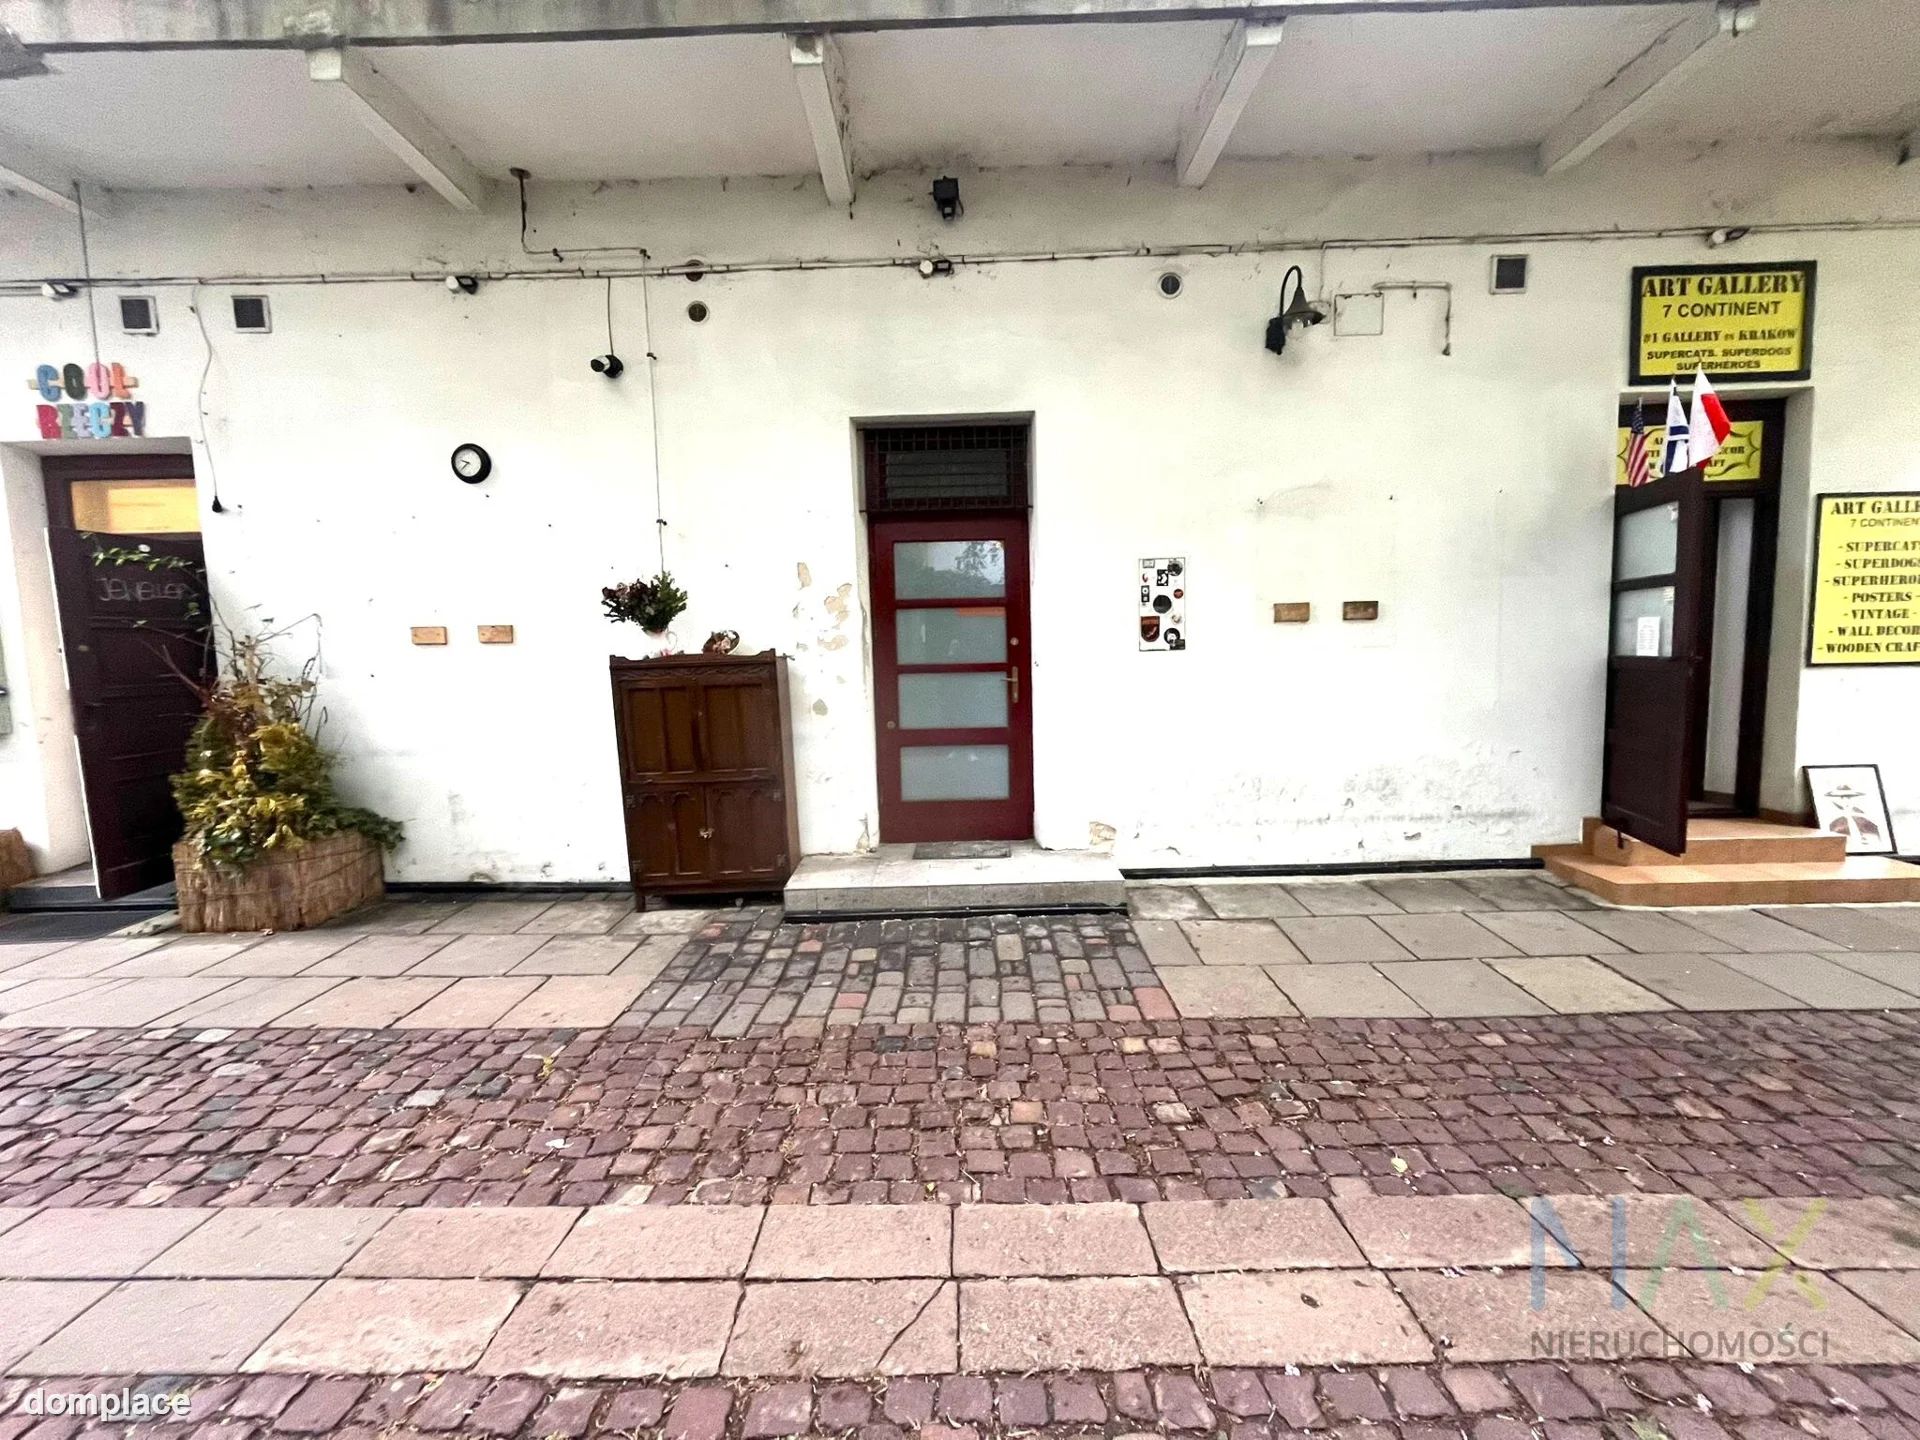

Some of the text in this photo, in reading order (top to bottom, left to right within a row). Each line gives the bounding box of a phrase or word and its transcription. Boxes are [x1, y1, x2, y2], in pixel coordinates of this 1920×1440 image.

[1642, 274, 1804, 298] ART GALLERY
[1662, 301, 1782, 318] 7 CONTINENT
[1662, 331, 1721, 343] GALLERY
[1738, 329, 1797, 341] KRAKOW
[1721, 347, 1792, 357] SUPERDOGS
[1676, 360, 1761, 371] SUPERHEROES
[36, 362, 132, 402] COOL
[1831, 501, 1866, 515] ART
[1850, 519, 1857, 528] 7
[1852, 592, 1912, 603] POSTERS
[1851, 608, 1910, 619] VINTAGE
[1837, 626, 1873, 636] WALL
[1826, 643, 1881, 653] WOODEN
